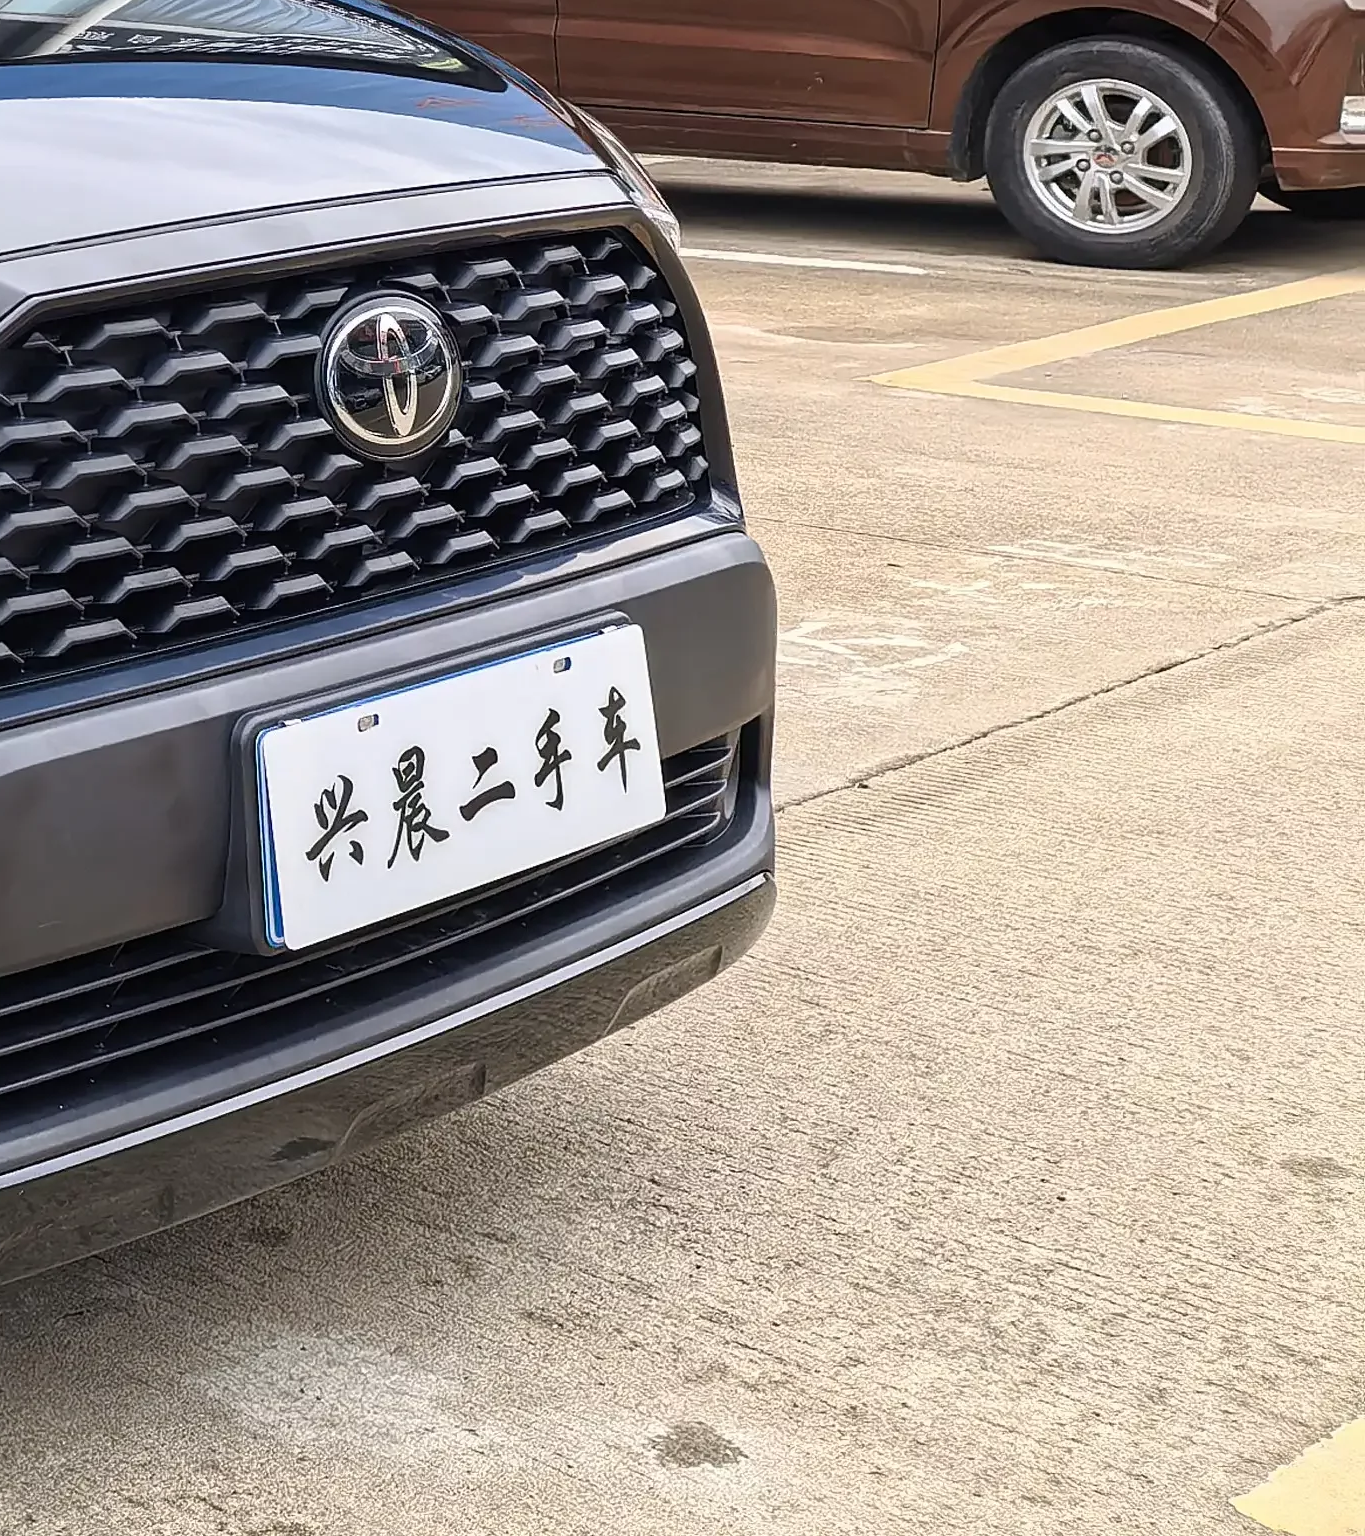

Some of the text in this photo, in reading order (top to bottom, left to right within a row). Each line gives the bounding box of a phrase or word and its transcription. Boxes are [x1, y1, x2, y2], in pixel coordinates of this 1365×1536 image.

[304, 685, 642, 883] 兴晨二手车
